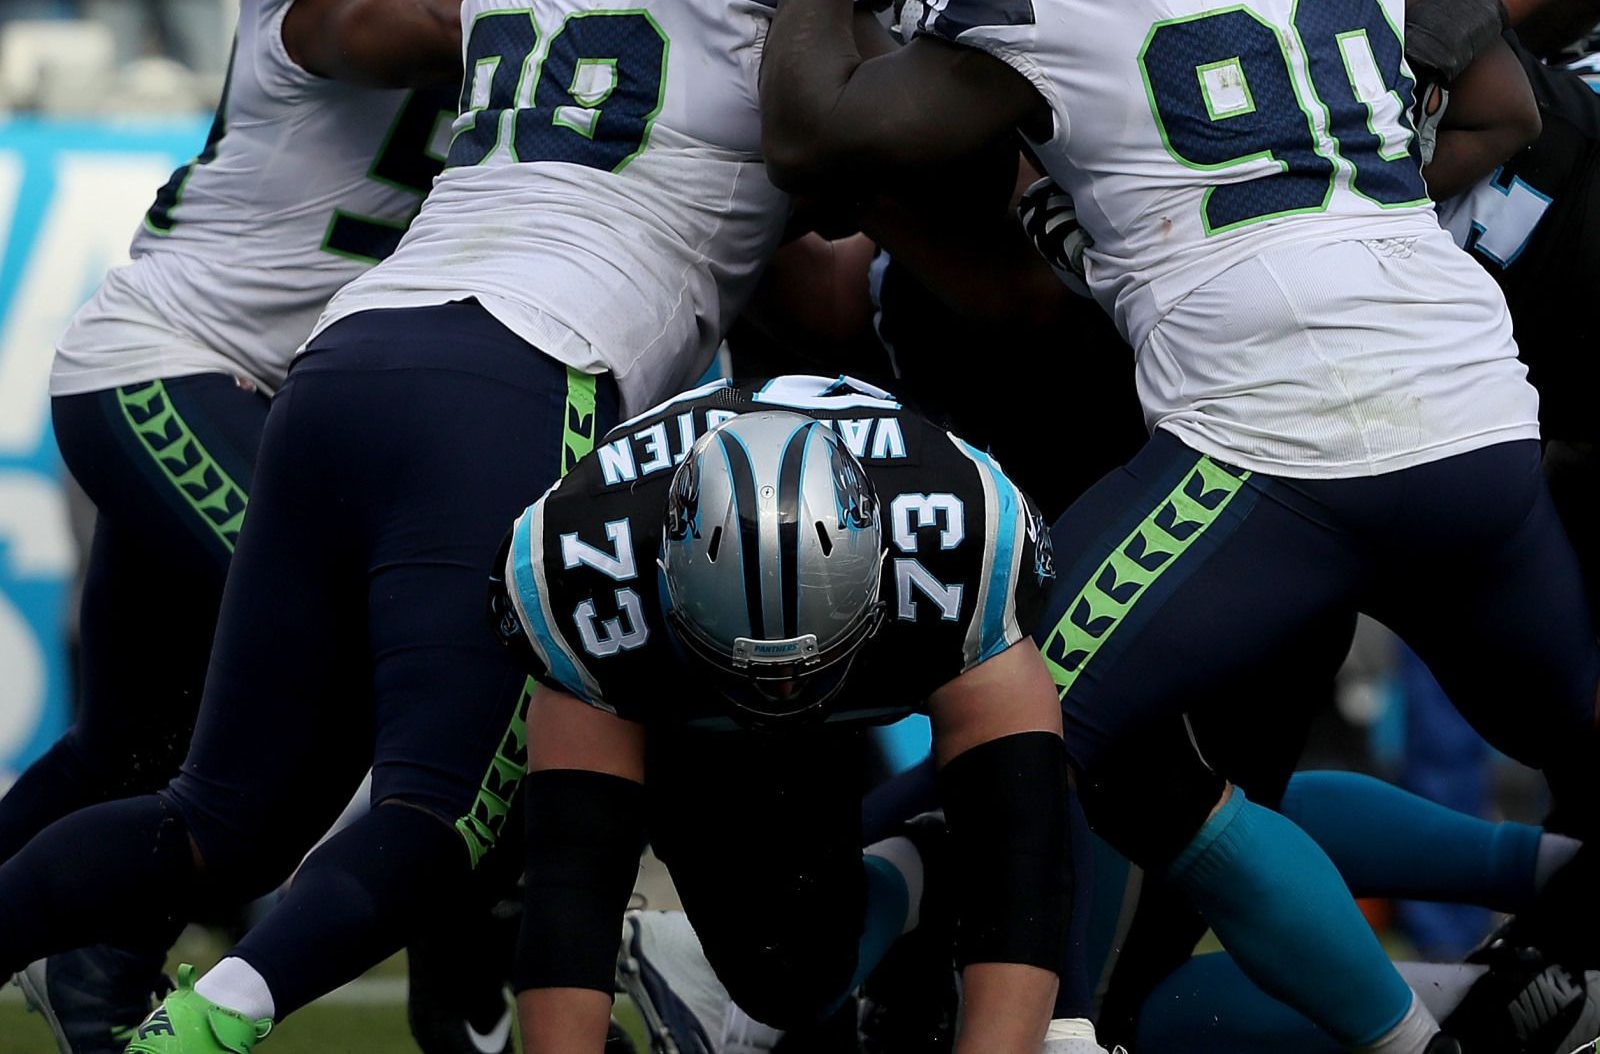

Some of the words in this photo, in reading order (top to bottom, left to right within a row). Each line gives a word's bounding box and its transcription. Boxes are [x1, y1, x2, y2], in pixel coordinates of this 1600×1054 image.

[560, 517, 651, 658] 73
[889, 492, 965, 622] 73
[1507, 964, 1584, 1041] NIKE
